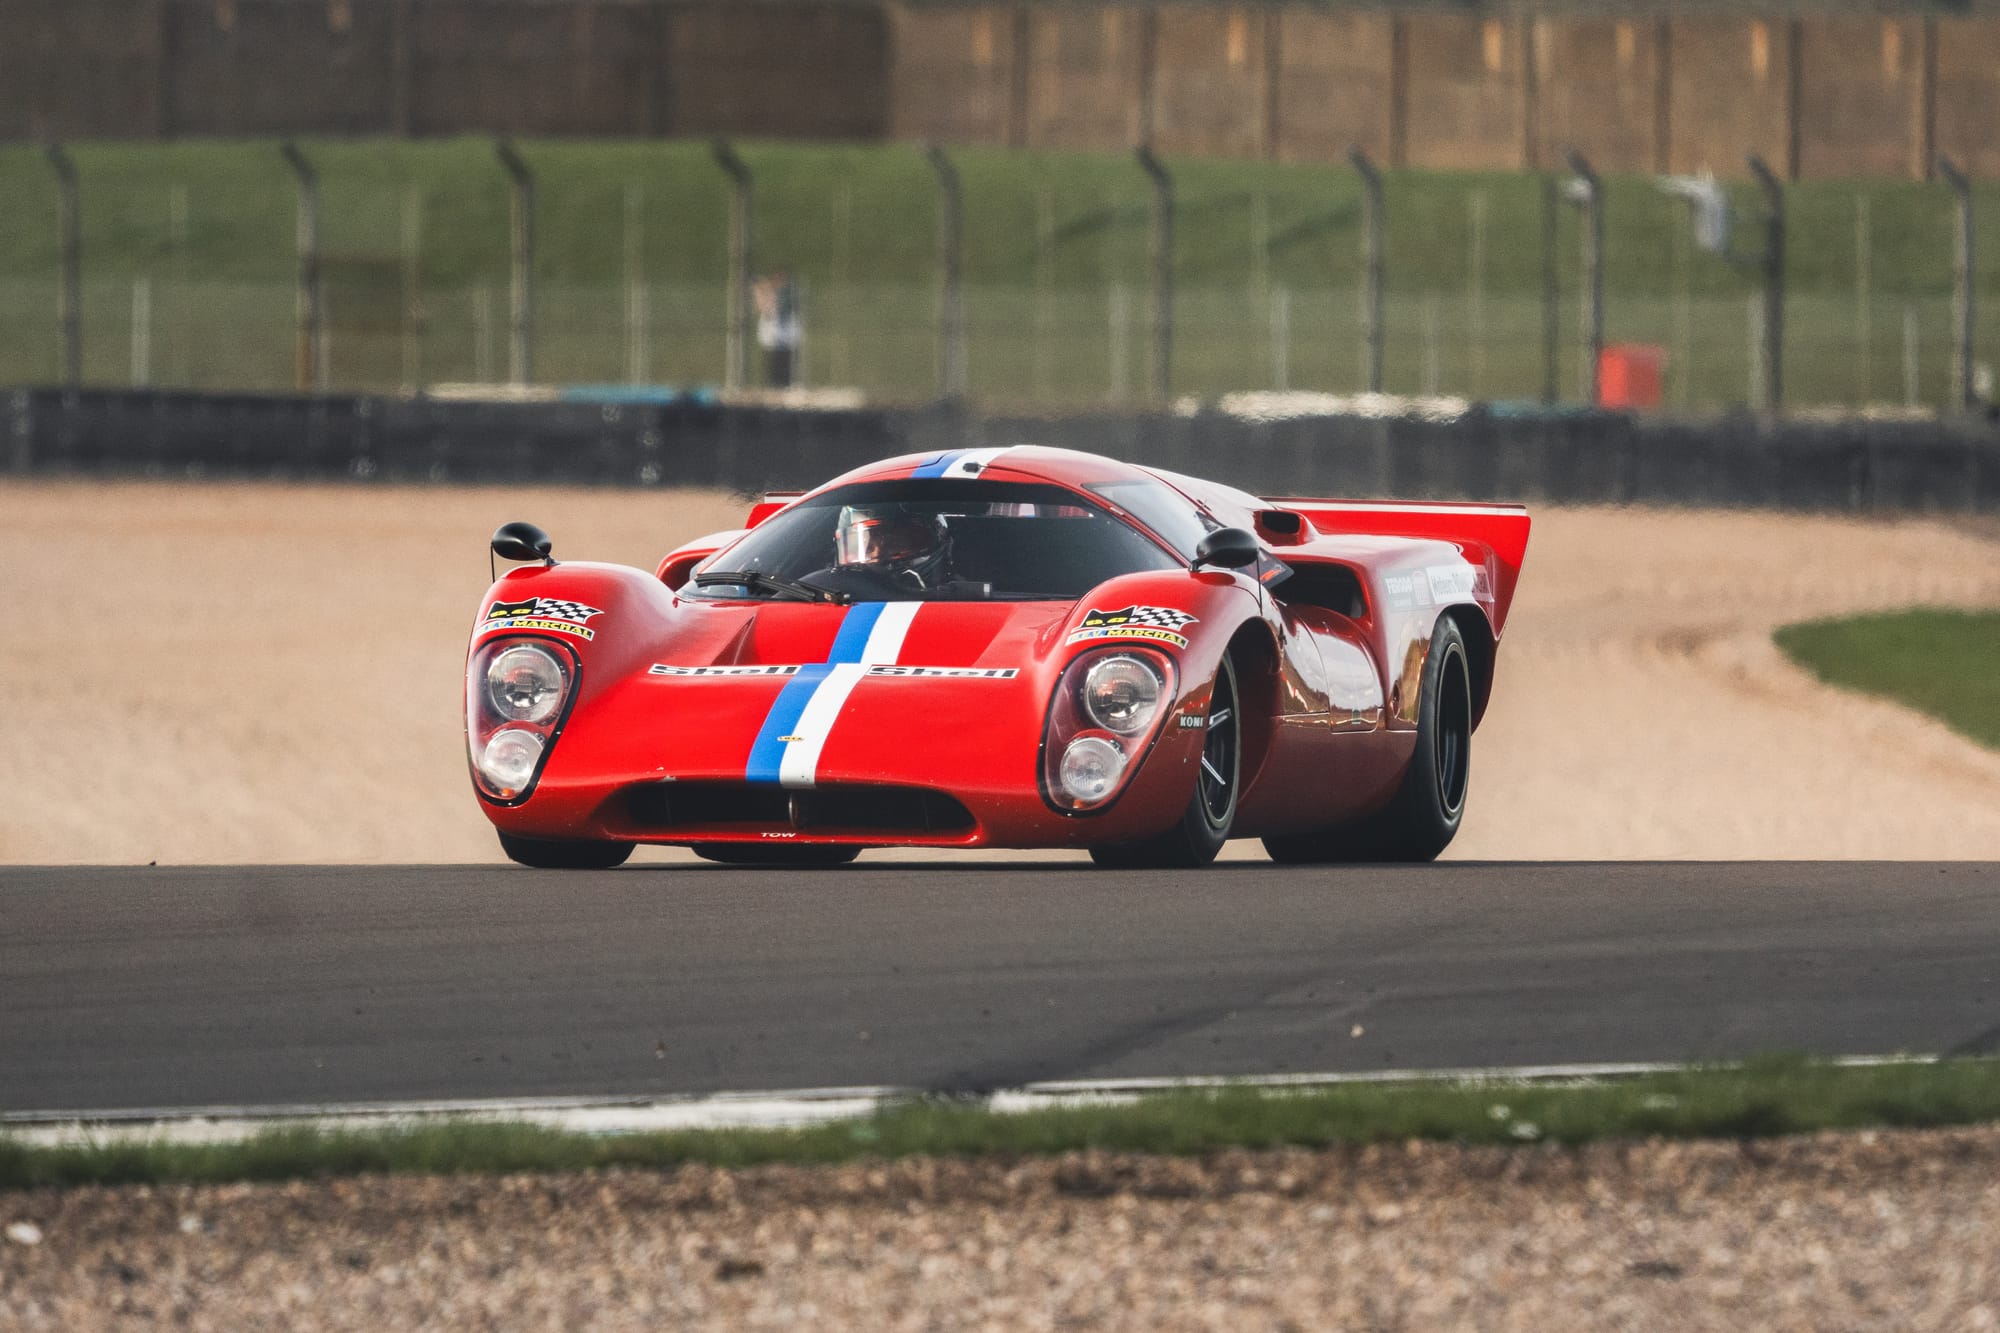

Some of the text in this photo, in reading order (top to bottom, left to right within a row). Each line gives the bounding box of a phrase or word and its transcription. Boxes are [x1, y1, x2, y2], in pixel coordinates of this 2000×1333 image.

[512, 619, 591, 638] MARCHAL
[1107, 629, 1185, 646] MARCHAL
[651, 665, 799, 676] Shell
[869, 667, 1016, 678] Shell
[1180, 716, 1204, 728] KONI
